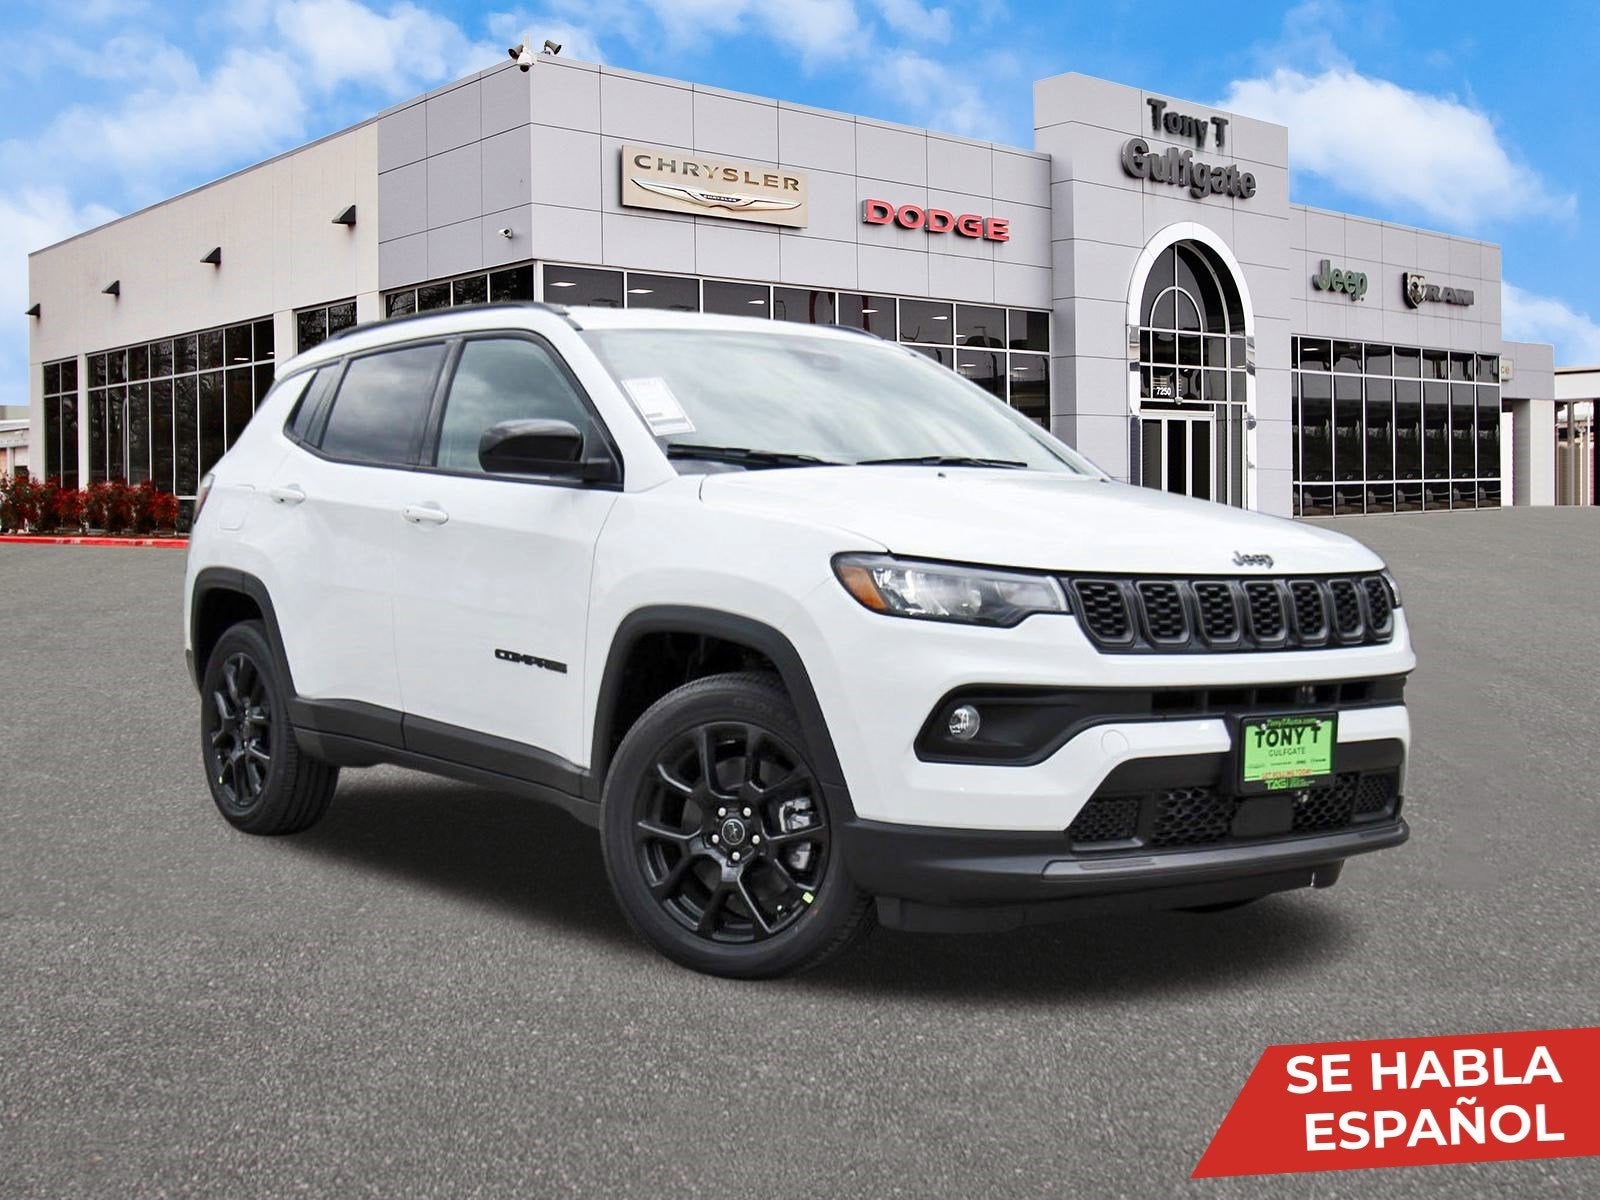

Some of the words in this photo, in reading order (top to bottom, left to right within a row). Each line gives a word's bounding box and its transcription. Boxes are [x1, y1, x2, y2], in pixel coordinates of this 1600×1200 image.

[1147, 98, 1208, 148] Tony
[1211, 117, 1229, 147] T
[633, 154, 800, 192] CHRYSLER
[1121, 138, 1256, 199] Gulfgate
[862, 198, 1011, 242] DODGE
[1313, 259, 1368, 301] Jeep
[1424, 284, 1475, 306] RAM
[1232, 550, 1274, 570] Jeep
[1255, 727, 1306, 748] TONY
[1311, 724, 1321, 743] T
